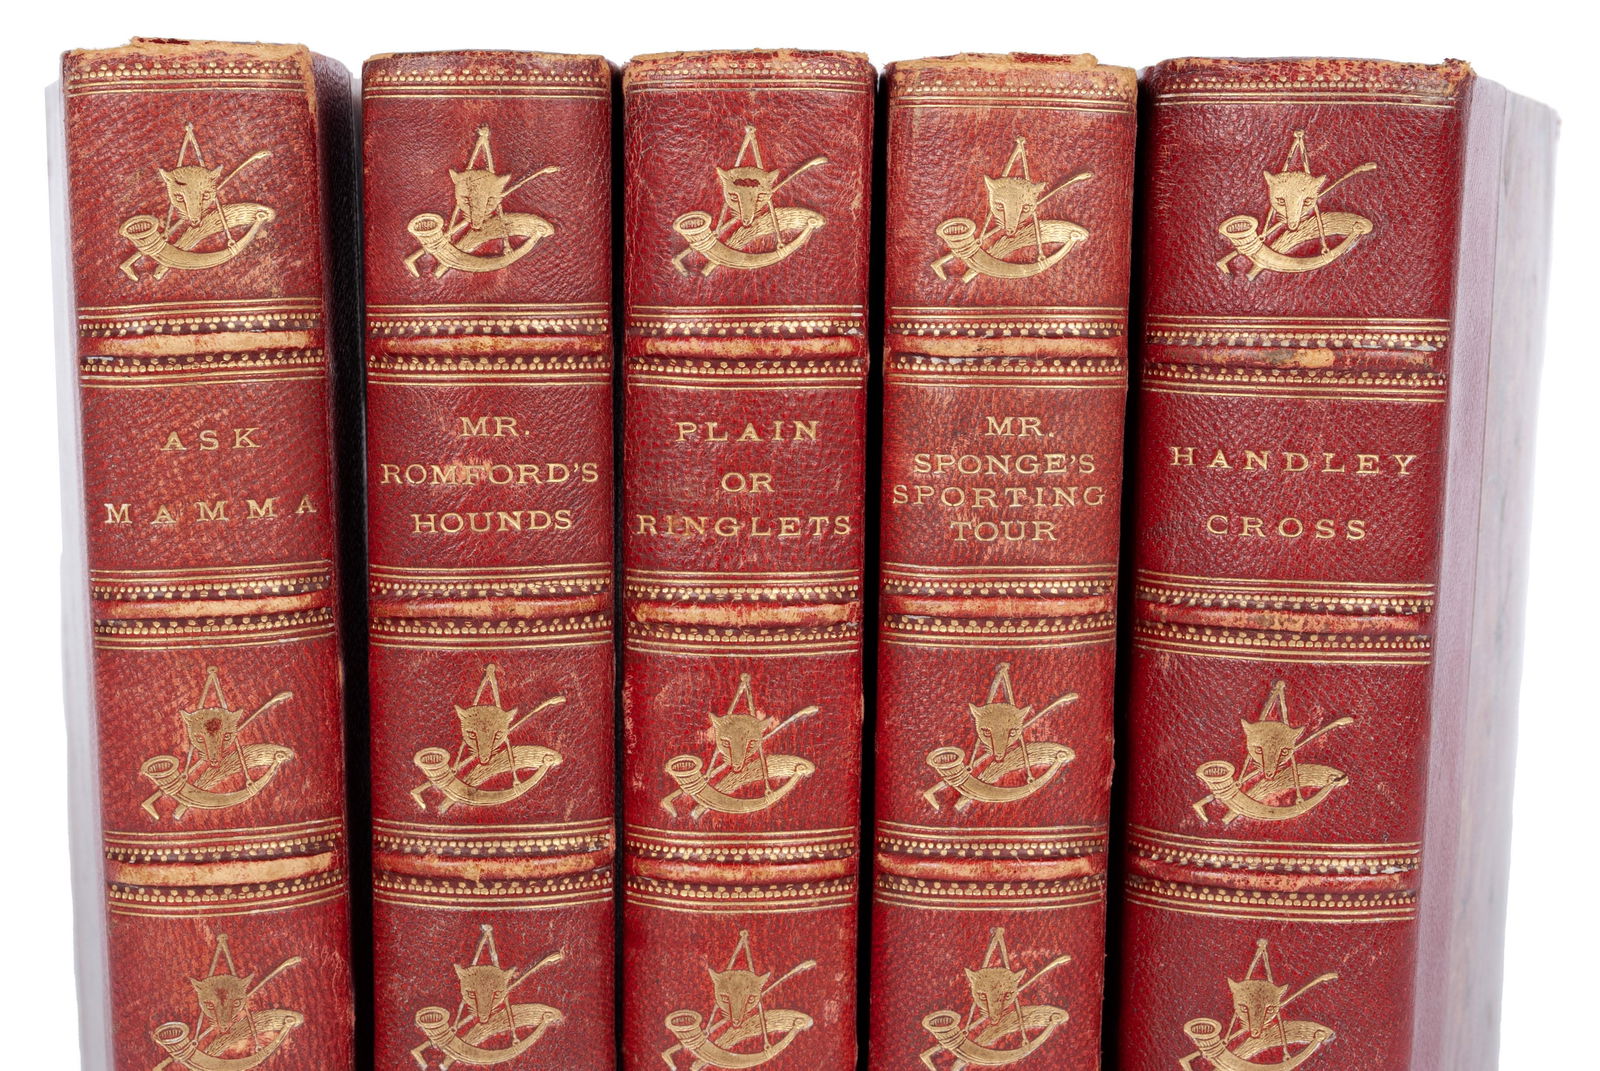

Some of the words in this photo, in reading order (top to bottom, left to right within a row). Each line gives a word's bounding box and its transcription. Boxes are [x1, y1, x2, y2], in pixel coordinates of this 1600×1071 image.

[160, 427, 260, 451] ASK
[458, 416, 532, 438] MR.
[675, 419, 820, 443] PLAIN
[984, 416, 1054, 438] MR.
[913, 453, 1095, 476] SPONGE'S
[1170, 446, 1417, 476] HANDLEY
[380, 462, 599, 486] ROMFORD'S
[721, 472, 775, 493] OR
[892, 484, 1106, 508] SPORTING
[104, 495, 317, 525] MAMMA
[412, 509, 573, 534] HOUNDS
[636, 514, 851, 537] RINGLETS
[950, 520, 1057, 542] TOUR
[1206, 514, 1367, 540] CROSS
